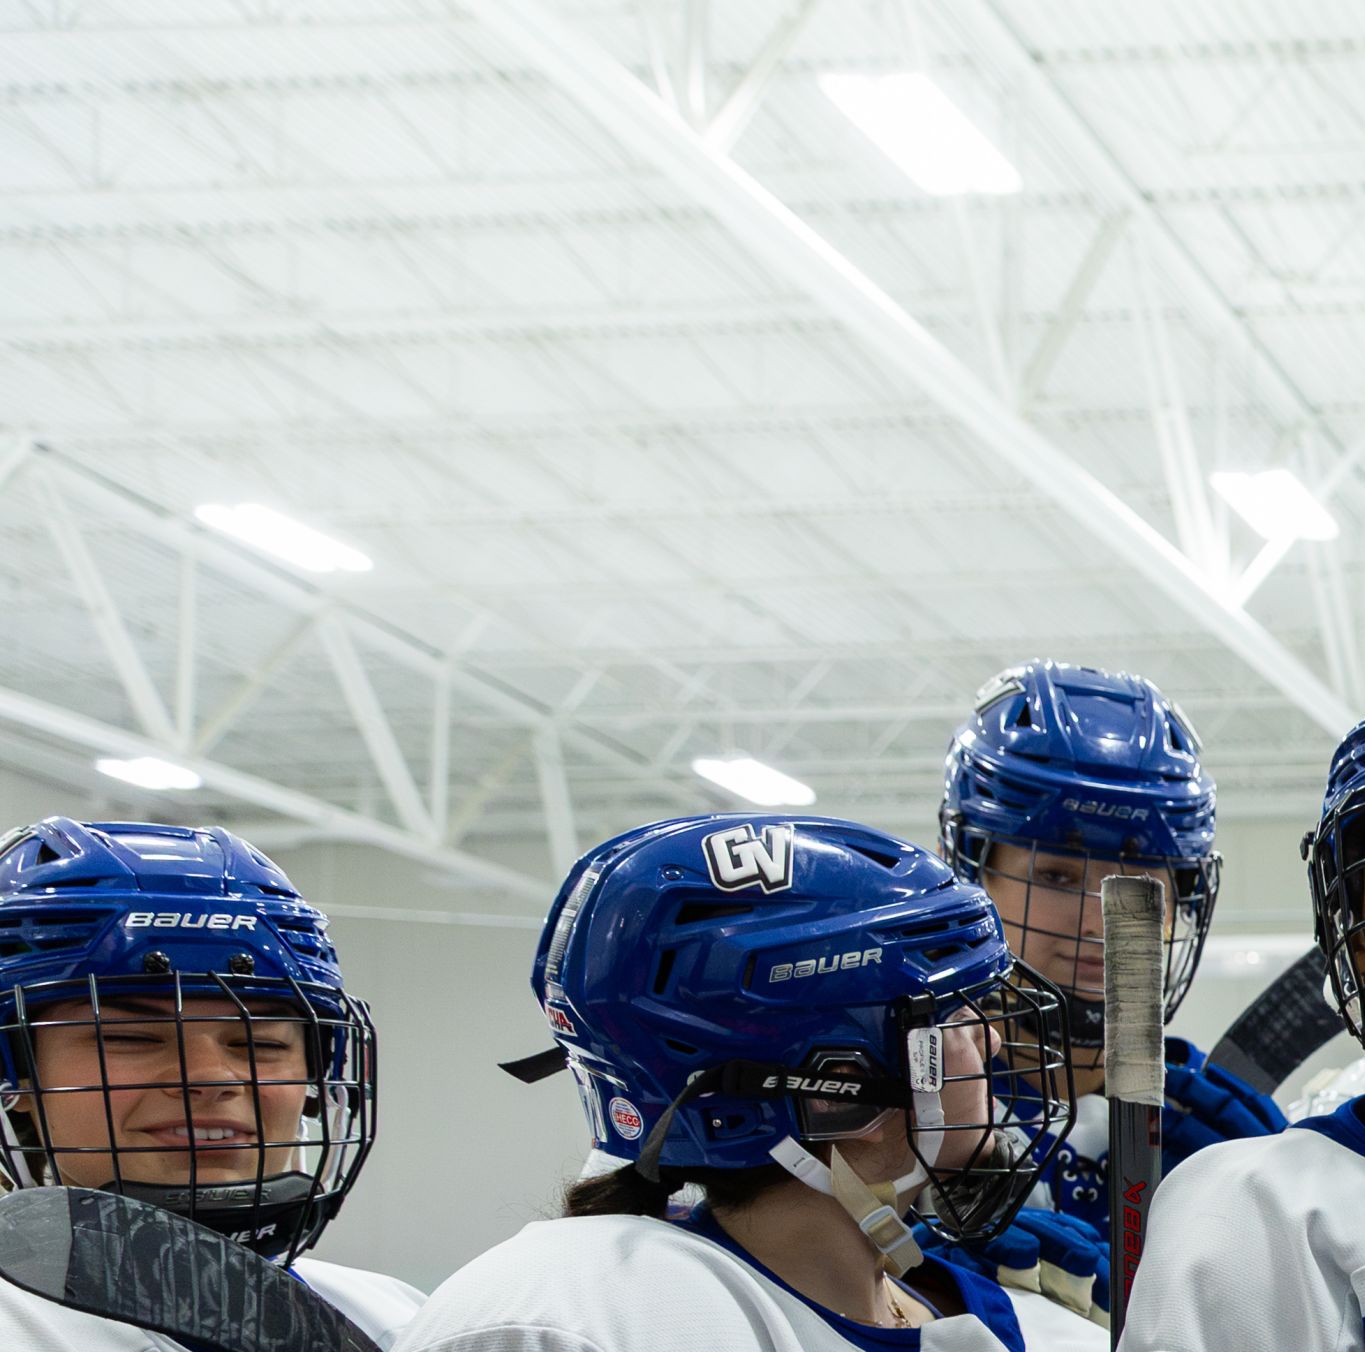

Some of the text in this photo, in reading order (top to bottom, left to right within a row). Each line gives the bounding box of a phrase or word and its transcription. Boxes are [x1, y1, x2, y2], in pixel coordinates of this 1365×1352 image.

[706, 825, 791, 889] GV
[125, 911, 257, 931] BAUER
[769, 948, 882, 983] BAUER
[929, 1034, 937, 1087] BAUER
[763, 1076, 862, 1096] BAUER
